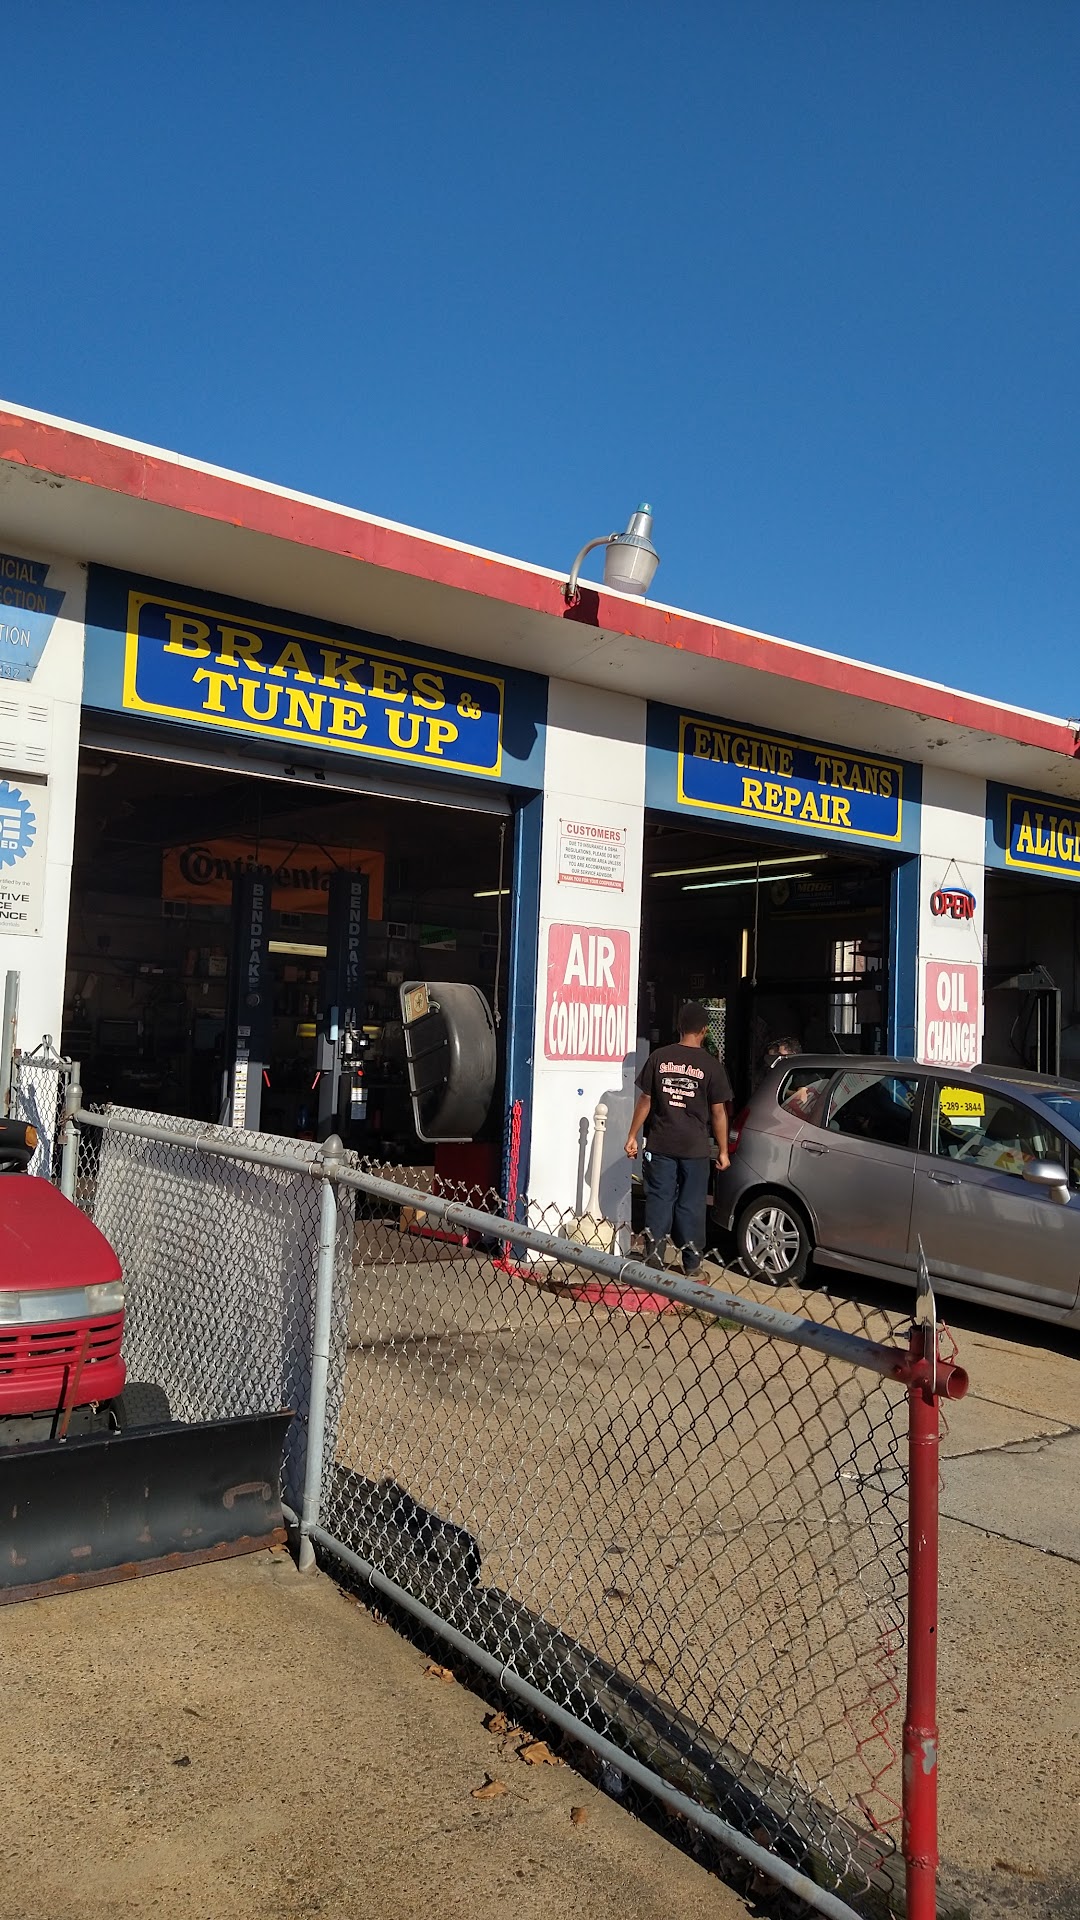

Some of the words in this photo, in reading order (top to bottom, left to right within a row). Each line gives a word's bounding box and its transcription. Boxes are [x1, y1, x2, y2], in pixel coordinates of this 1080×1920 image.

[163, 612, 446, 710] BRAKES
[457, 692, 481, 720] &
[192, 667, 368, 739] TUNE
[385, 708, 459, 755] UP
[693, 727, 794, 778] ENGINE
[815, 755, 893, 798] TRANS
[741, 777, 851, 826] REPAIR
[567, 824, 620, 841] CUSTOMERS
[583, 842, 604, 850] INSURANCE
[248, 883, 264, 977] BENDPAK
[346, 882, 362, 977] BENDPAK
[930, 889, 975, 920] OPEN
[564, 932, 616, 988] AIR
[936, 971, 968, 1013] OIL
[548, 1000, 627, 1057] CONDITION
[927, 1020, 976, 1063] CHANGE
